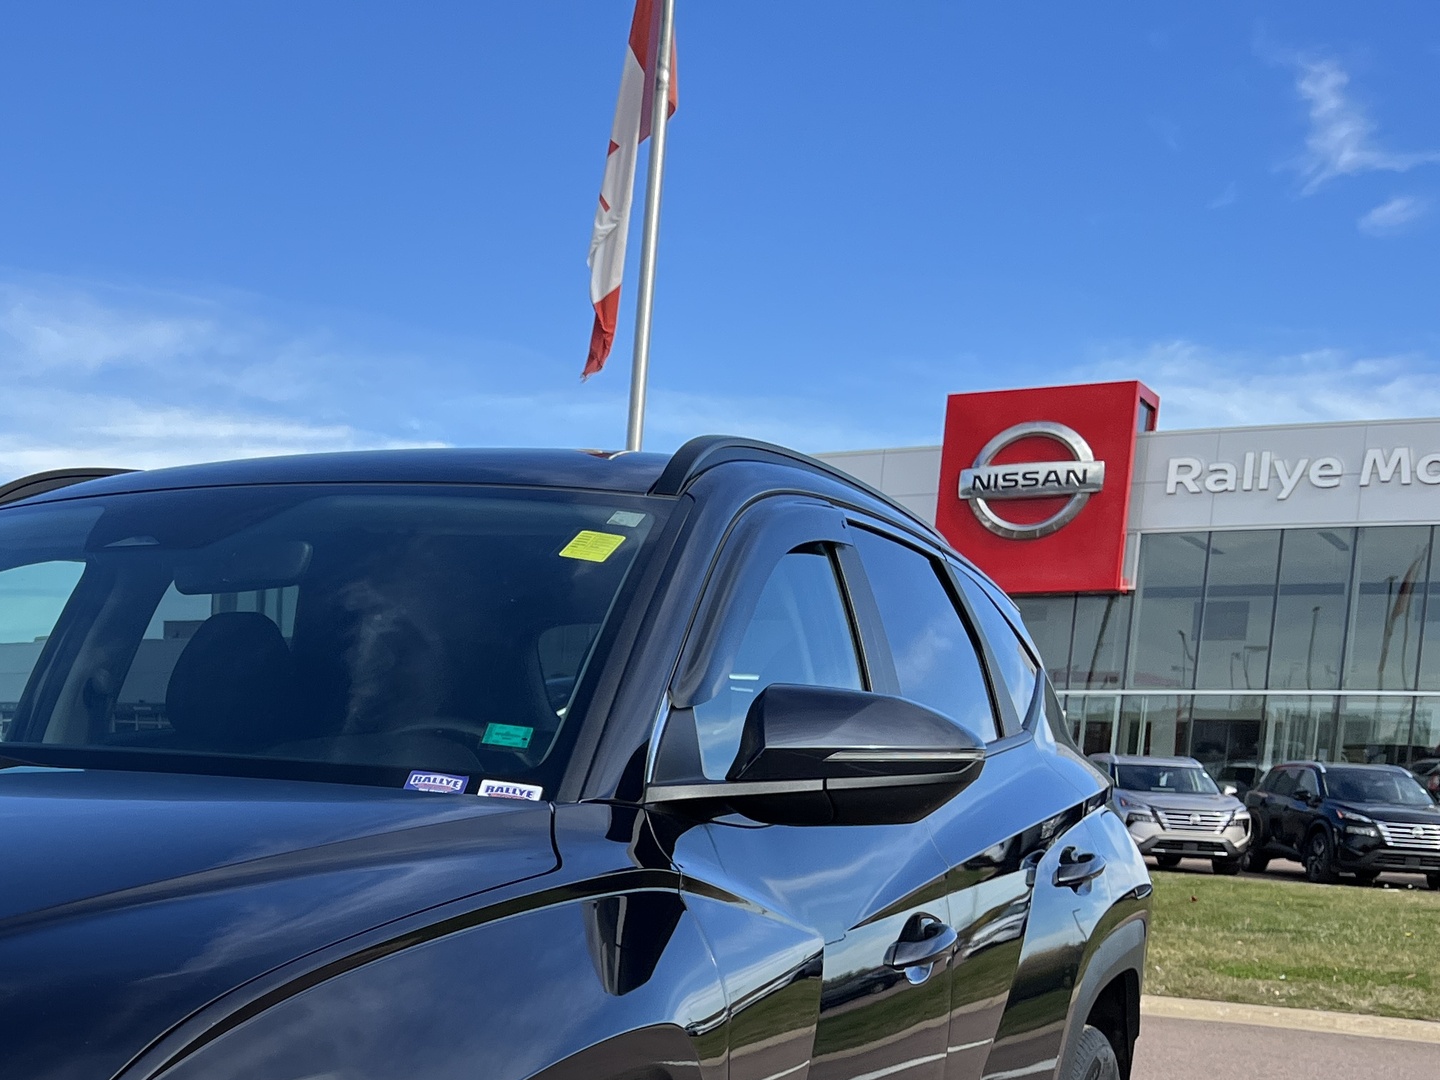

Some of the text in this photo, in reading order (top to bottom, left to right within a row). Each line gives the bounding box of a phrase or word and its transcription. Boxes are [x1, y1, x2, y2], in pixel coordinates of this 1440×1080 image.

[970, 467, 1089, 492] NISSAN
[1165, 450, 1344, 501] Rallye
[411, 775, 461, 789] RALLYE
[484, 785, 534, 799] RALLYE
